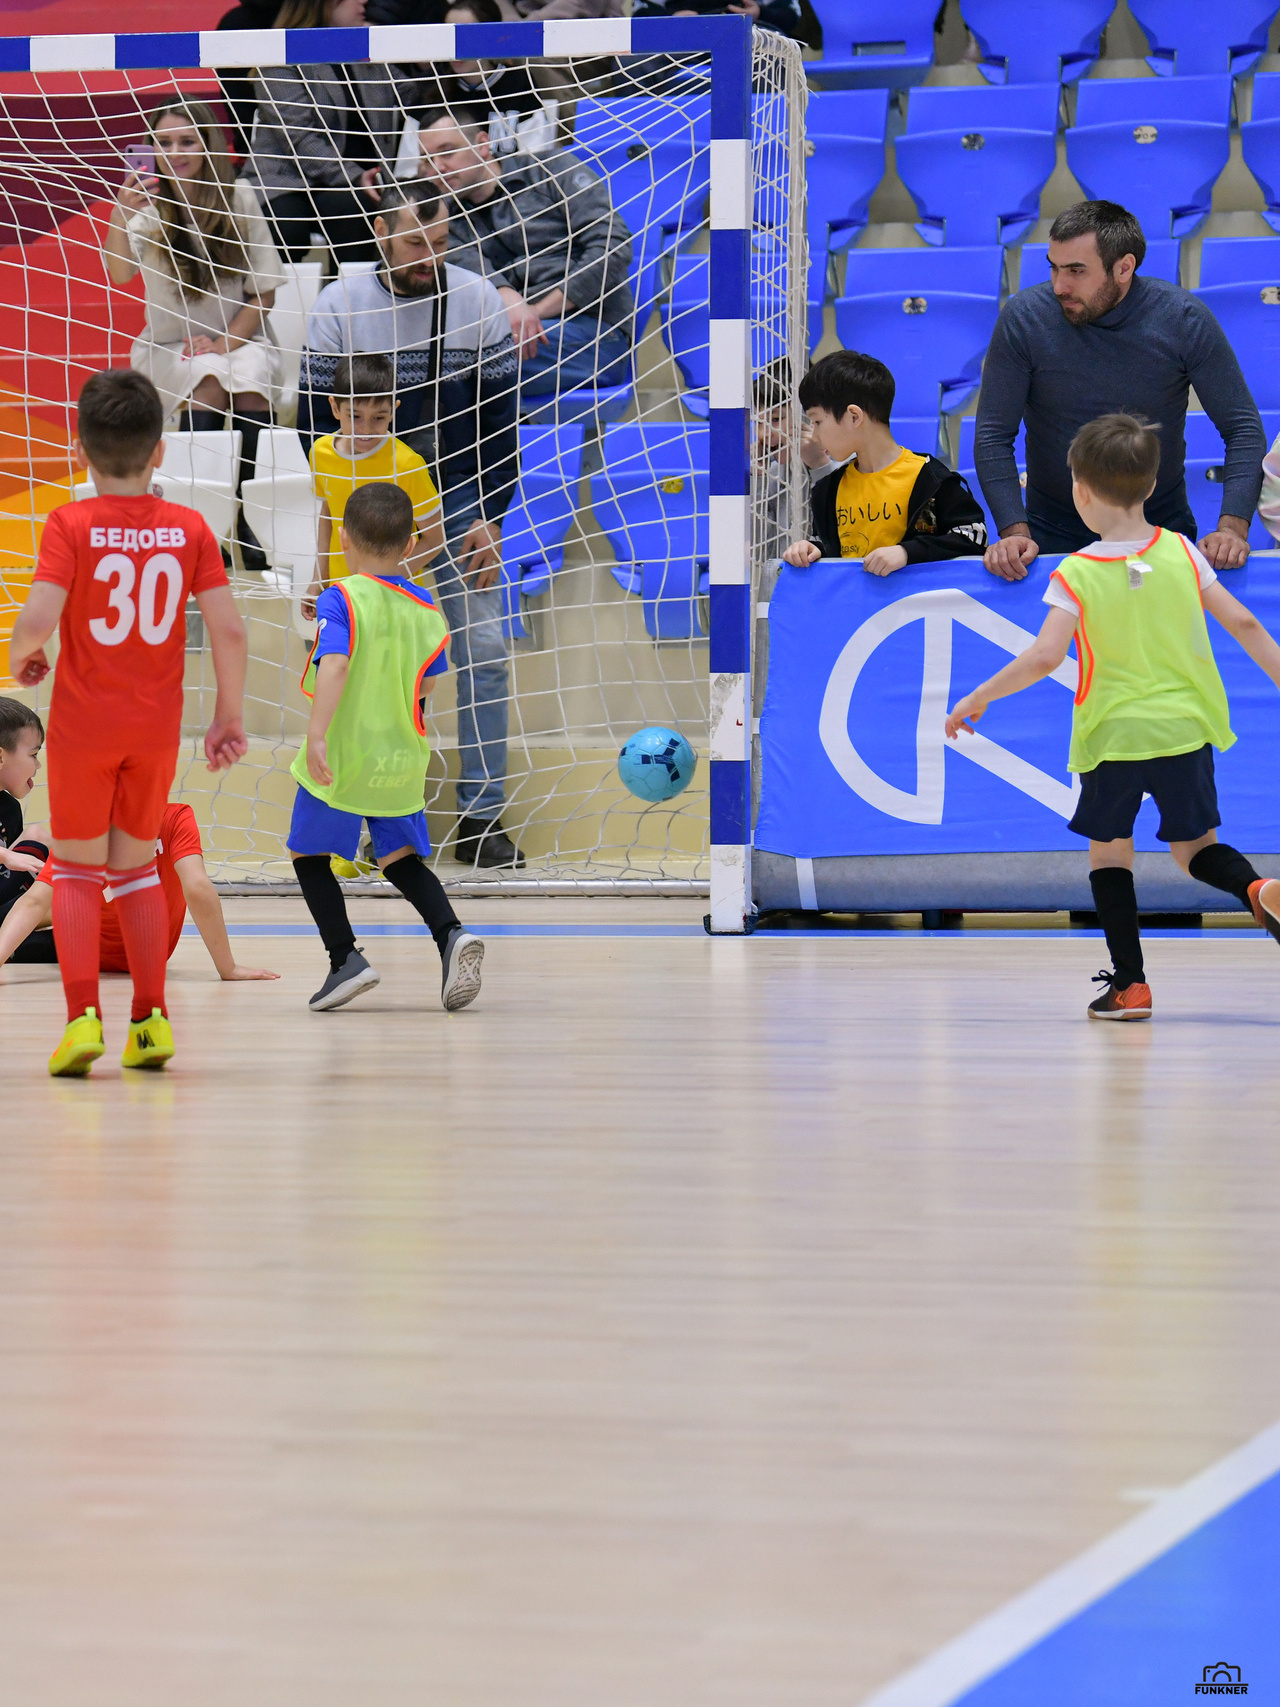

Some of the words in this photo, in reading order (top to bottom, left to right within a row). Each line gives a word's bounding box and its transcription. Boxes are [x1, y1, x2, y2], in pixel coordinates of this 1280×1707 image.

[837, 502, 902, 526] おいしい
[90, 527, 186, 553] БЕДОЕВ
[88, 552, 183, 646] 30
